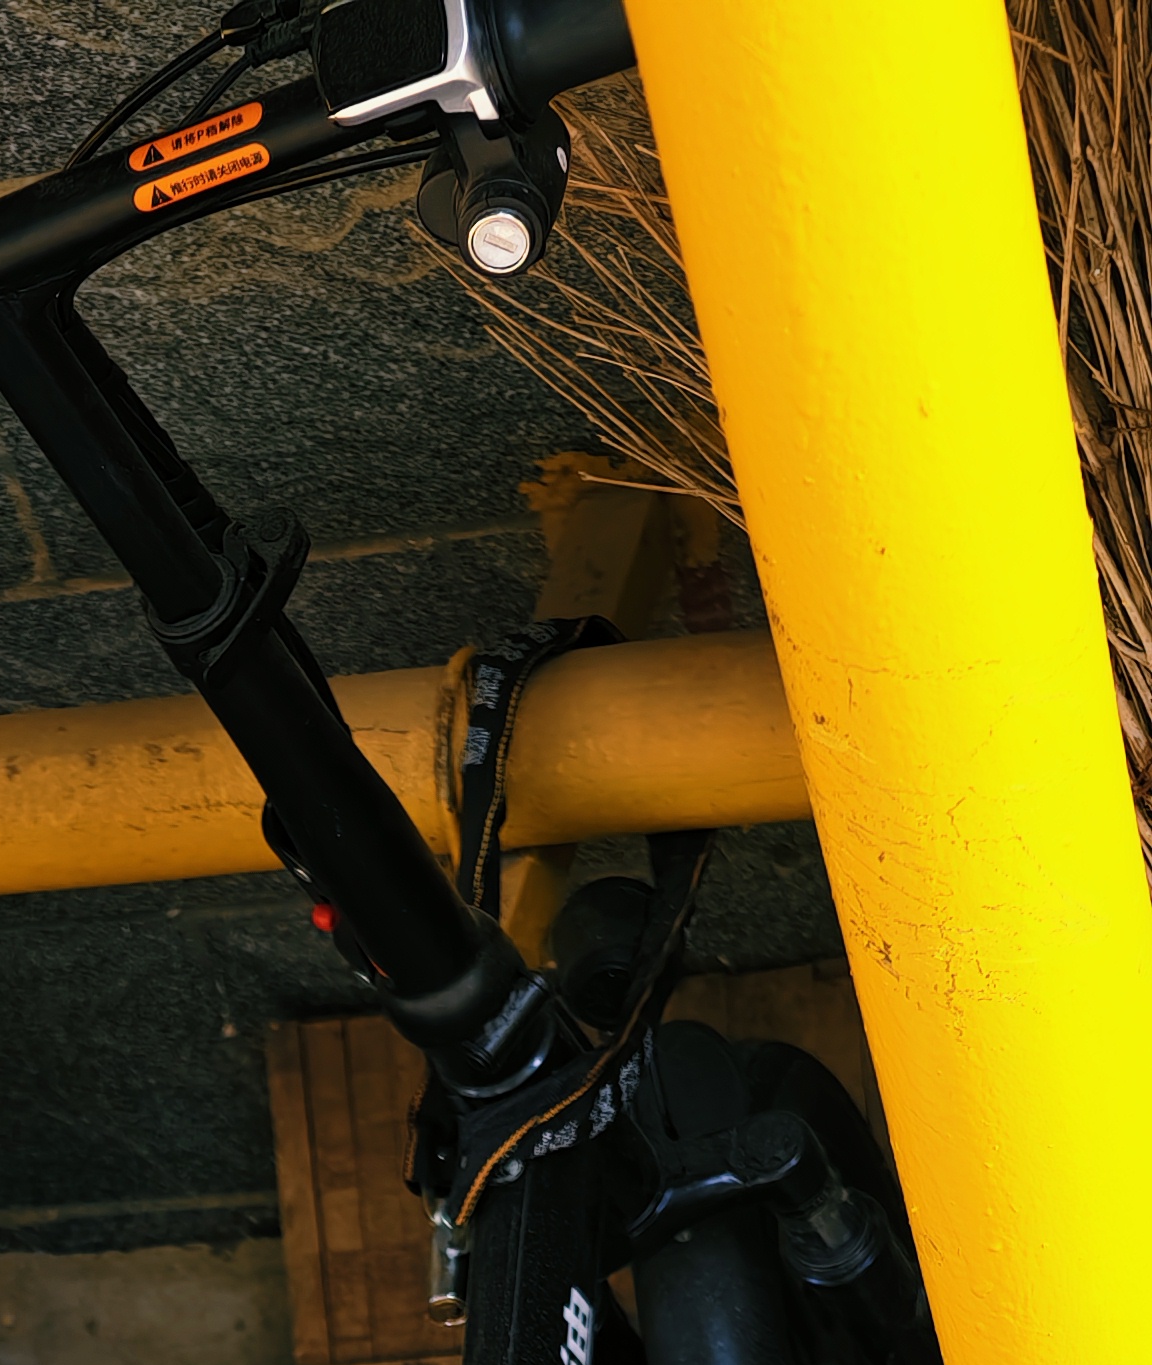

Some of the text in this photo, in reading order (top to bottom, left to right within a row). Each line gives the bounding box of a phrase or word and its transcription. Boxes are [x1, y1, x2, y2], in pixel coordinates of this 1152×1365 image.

[169, 151, 264, 196] 推行时请关闭电源
